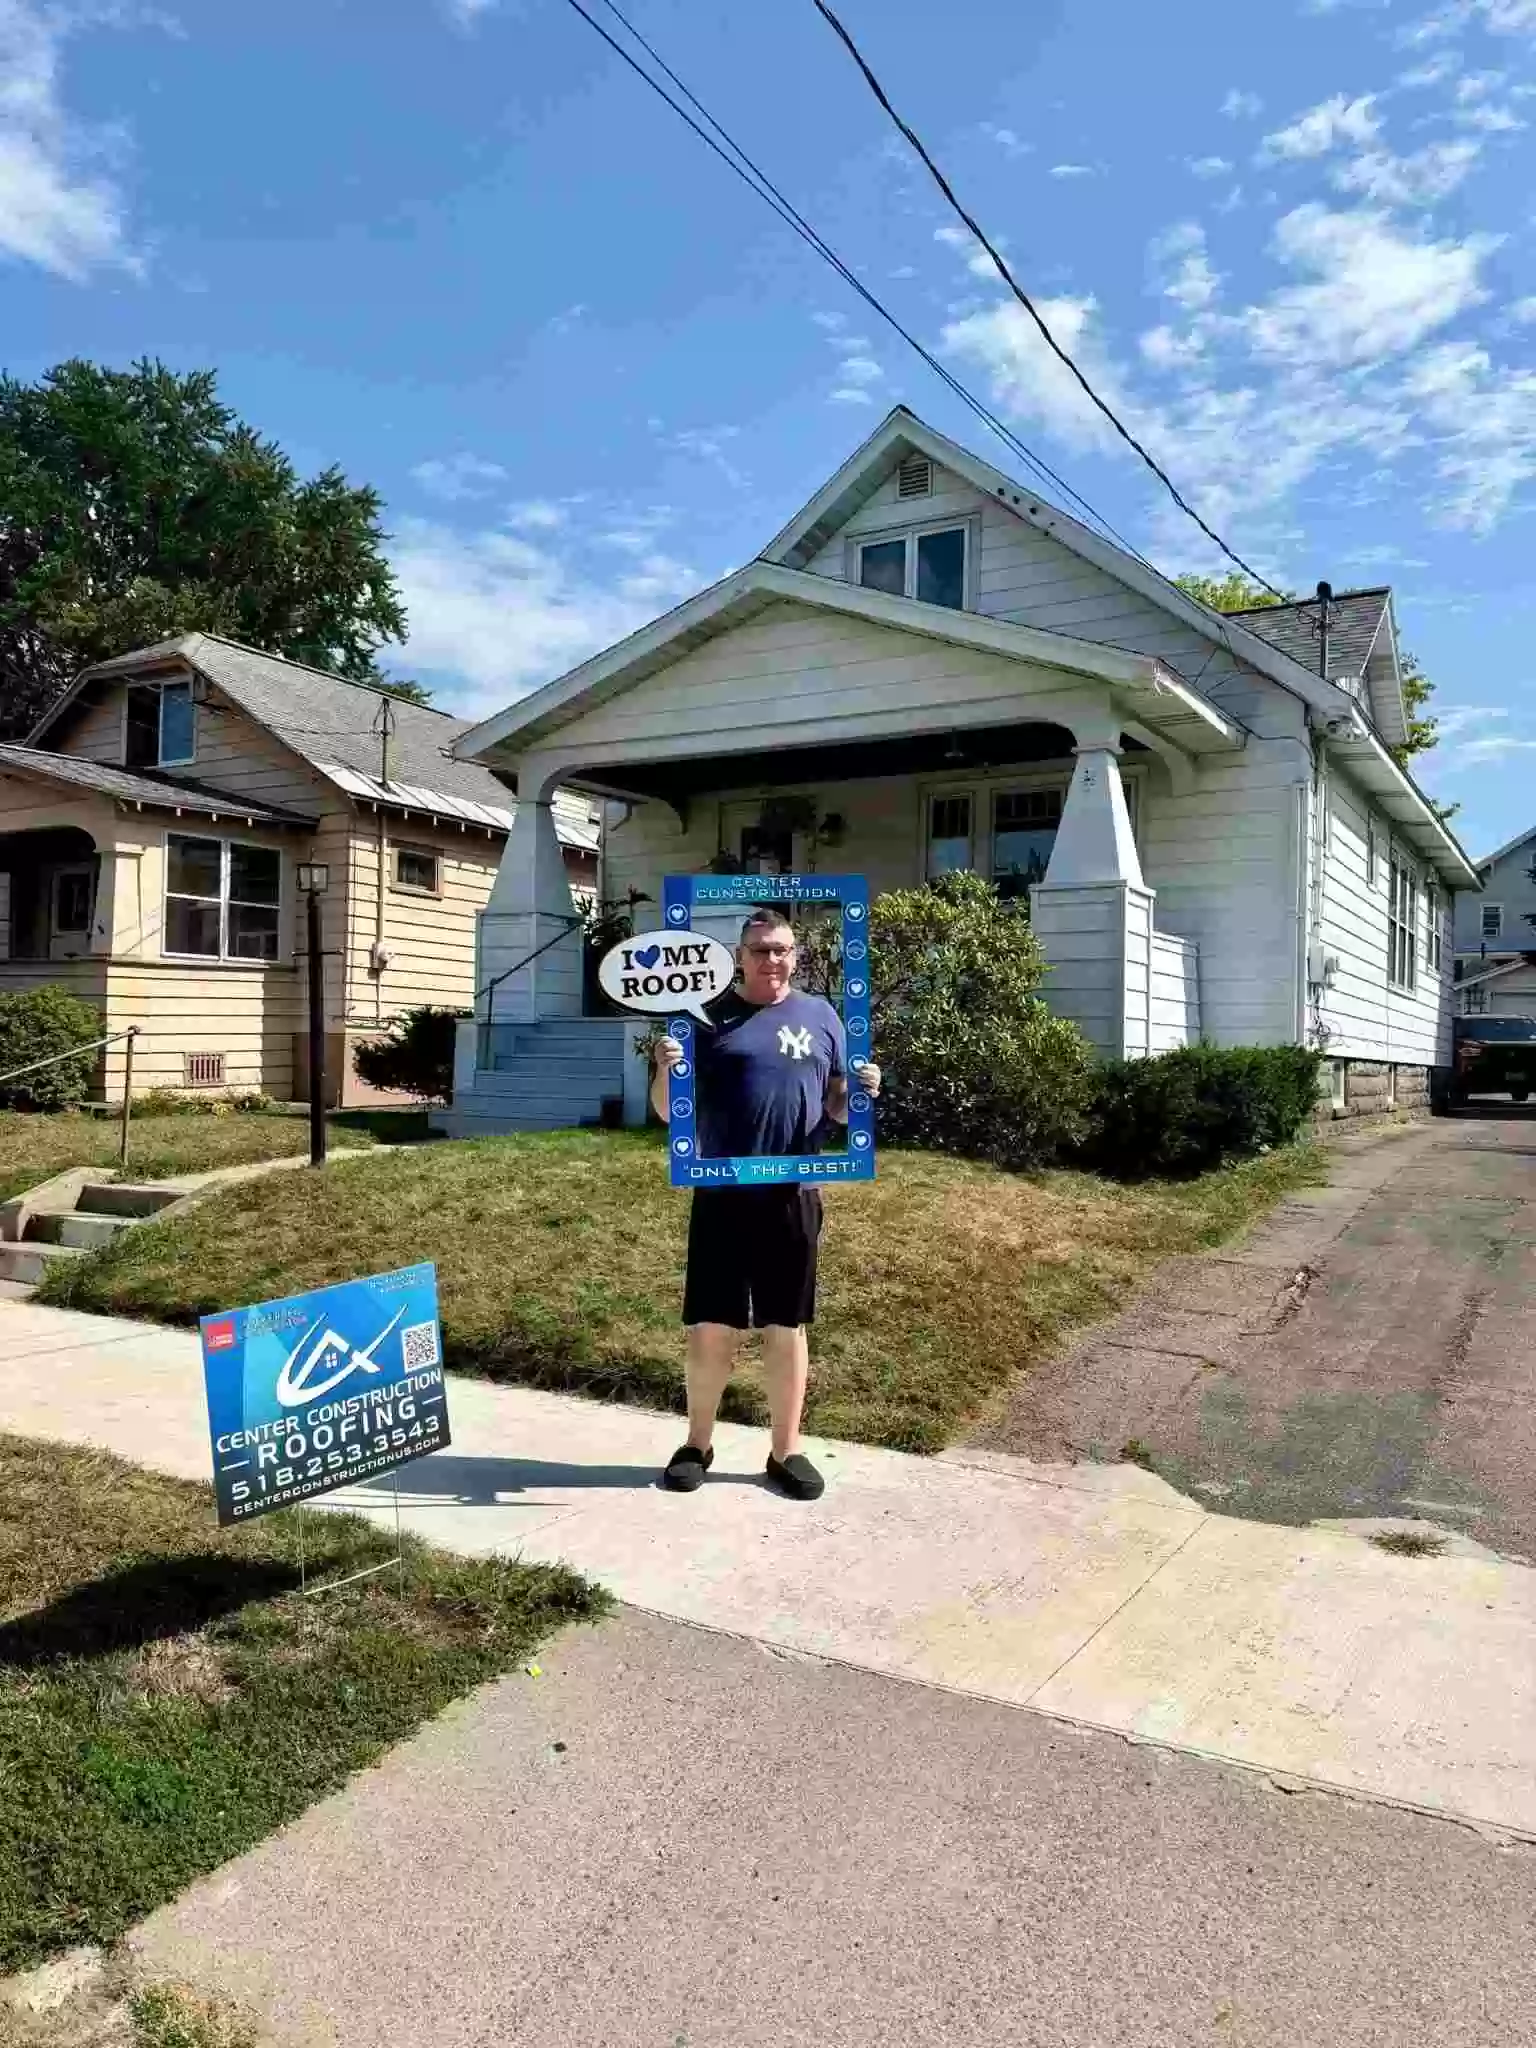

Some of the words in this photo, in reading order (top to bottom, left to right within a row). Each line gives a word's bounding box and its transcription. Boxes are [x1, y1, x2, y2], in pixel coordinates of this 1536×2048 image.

[696, 887, 837, 898] CONSTRUCTION
[732, 876, 801, 887] CENTER
[664, 943, 711, 966] MY
[621, 970, 717, 998] ROOF!
[751, 1163, 790, 1177] THE
[216, 1415, 300, 1453] CENTER
[307, 1367, 442, 1427] CONSTRUCTION
[258, 1396, 416, 1469] ROOFING
[231, 1415, 440, 1500] 518.253.3543
[233, 1436, 441, 1516] CENTERCONSTRUCTIONUS.COM
